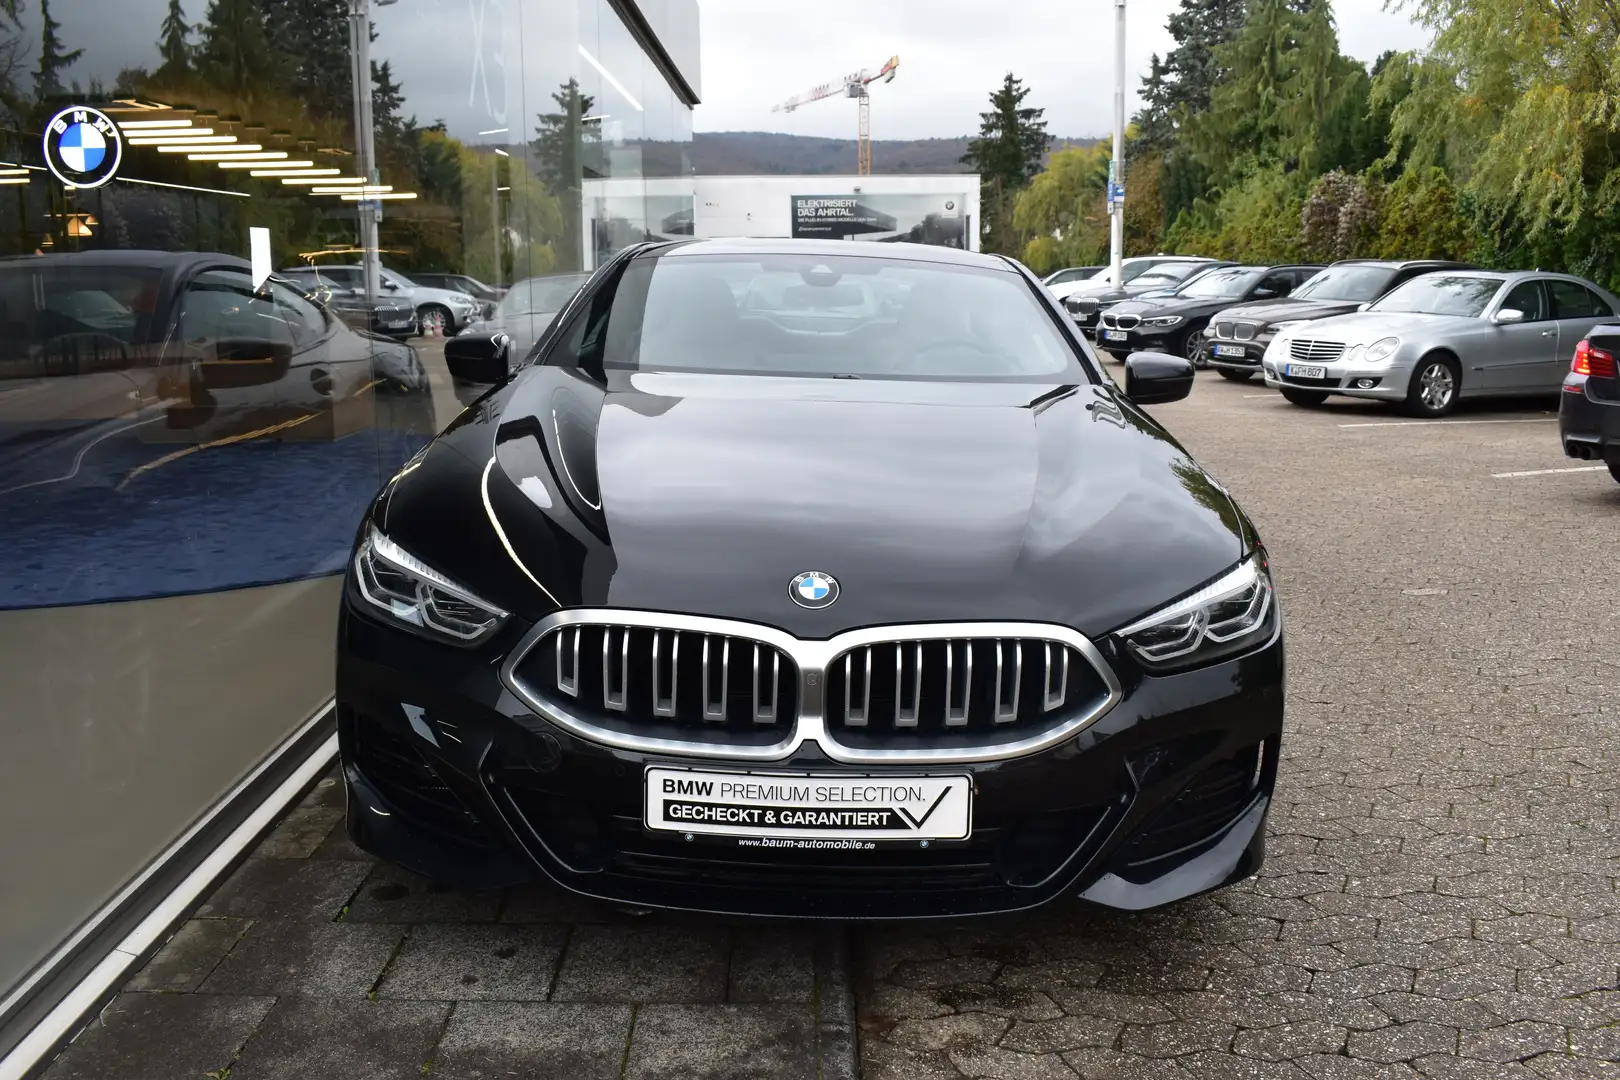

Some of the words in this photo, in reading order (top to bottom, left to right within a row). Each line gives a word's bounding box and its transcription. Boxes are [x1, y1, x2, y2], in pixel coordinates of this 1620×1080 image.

[53, 111, 110, 134] BMW
[797, 200, 857, 208] ELEKTRISIERT
[797, 208, 816, 217] DAS
[817, 208, 854, 216] AHRTAL.
[662, 778, 714, 796] BMW
[720, 782, 810, 802] PREMIUM
[815, 786, 926, 802] SELECTION.
[669, 804, 762, 823] GECHECKT
[764, 810, 777, 824] &
[780, 811, 891, 825] GARANTIERT
[738, 837, 876, 850] www.baum-automobile.de
